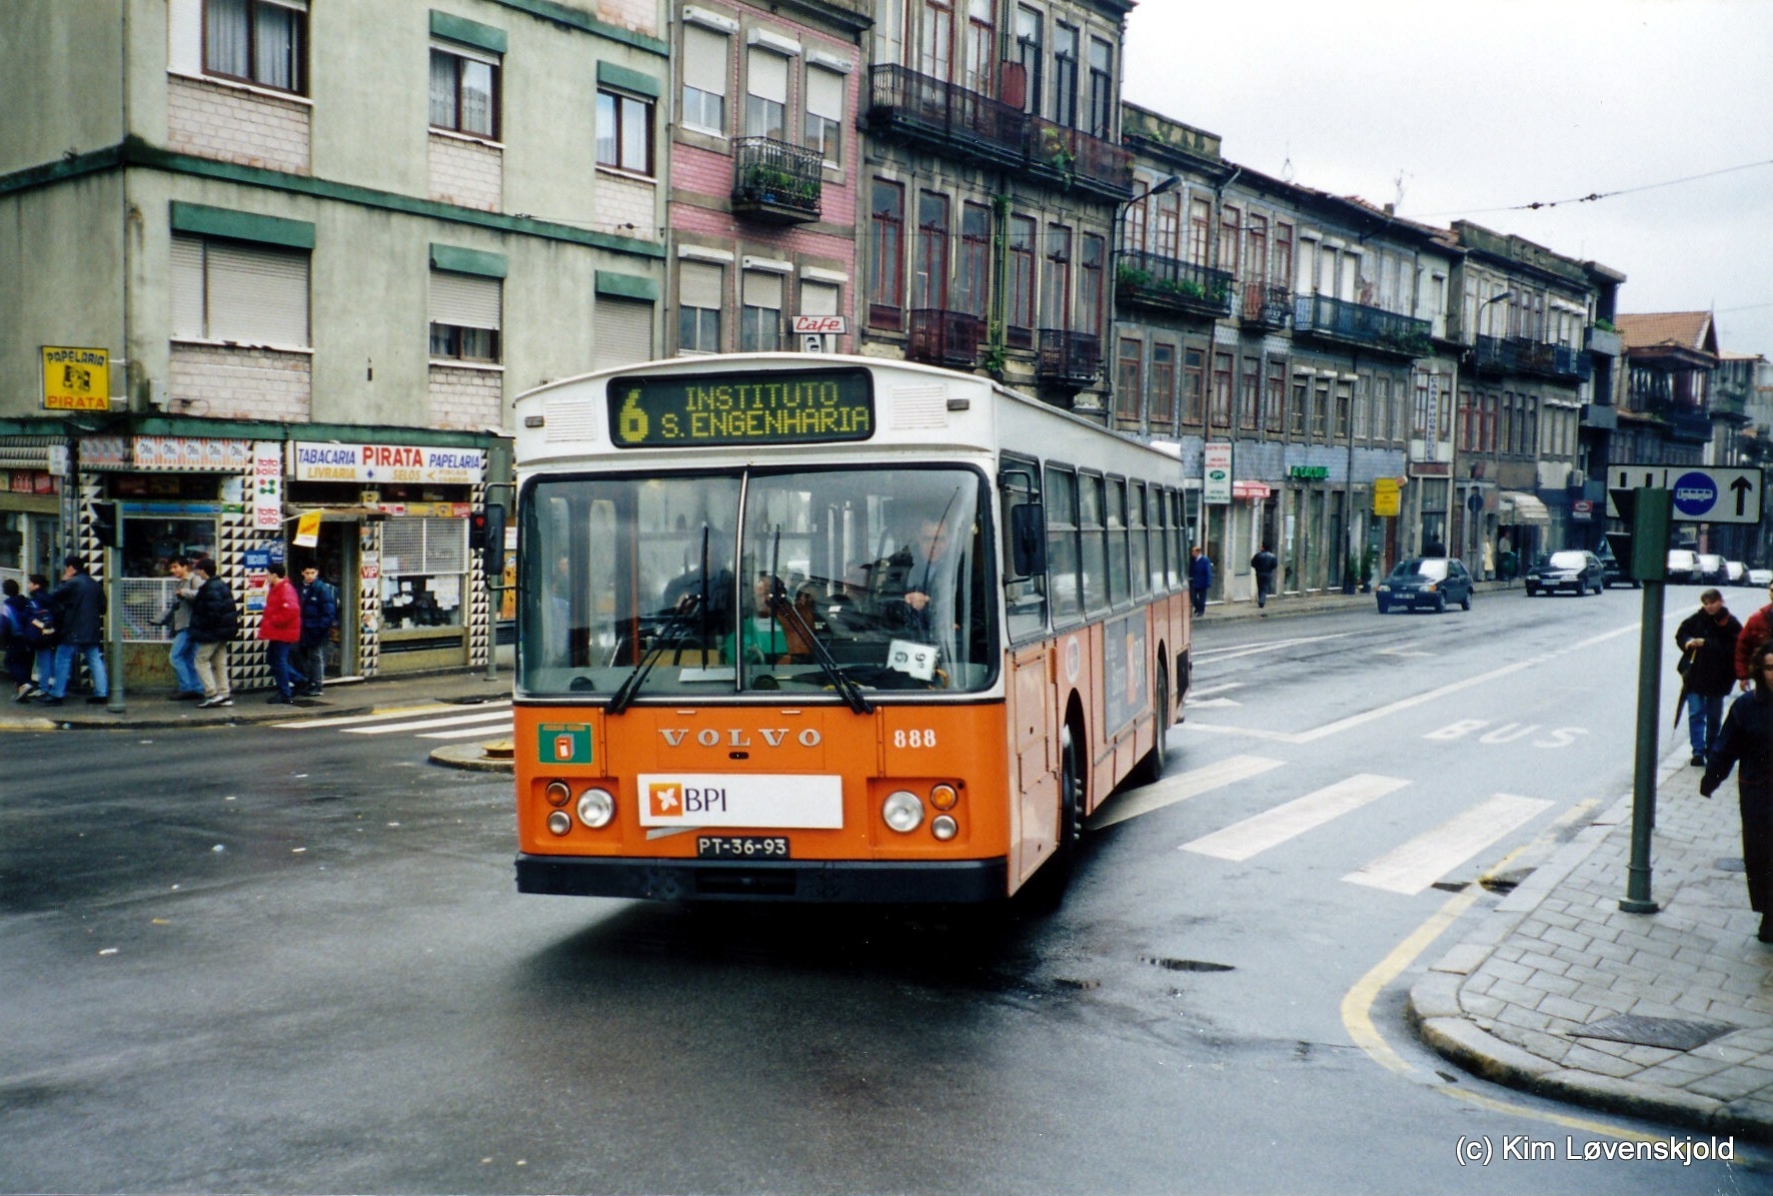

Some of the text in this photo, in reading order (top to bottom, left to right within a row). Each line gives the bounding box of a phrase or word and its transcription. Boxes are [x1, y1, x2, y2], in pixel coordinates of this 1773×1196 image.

[796, 316, 842, 332] Cafe
[46, 350, 105, 367] PAPELARIA
[47, 395, 106, 409] PIRATA
[685, 381, 839, 411] INSTITUTO
[619, 388, 649, 443] 6
[258, 458, 279, 467] toto
[298, 446, 480, 469] TABACARIA PIRATA PAPELARIA
[256, 466, 279, 476] bola
[307, 467, 357, 480] LIVRARIA
[392, 469, 421, 482] SELOS
[258, 508, 279, 517] toto
[258, 516, 279, 525] loto
[658, 728, 822, 747] VOLVO
[894, 729, 937, 748] 888
[1422, 719, 1590, 748] BUS
[684, 788, 727, 812] BPI
[698, 838, 787, 856] PT-36-93
